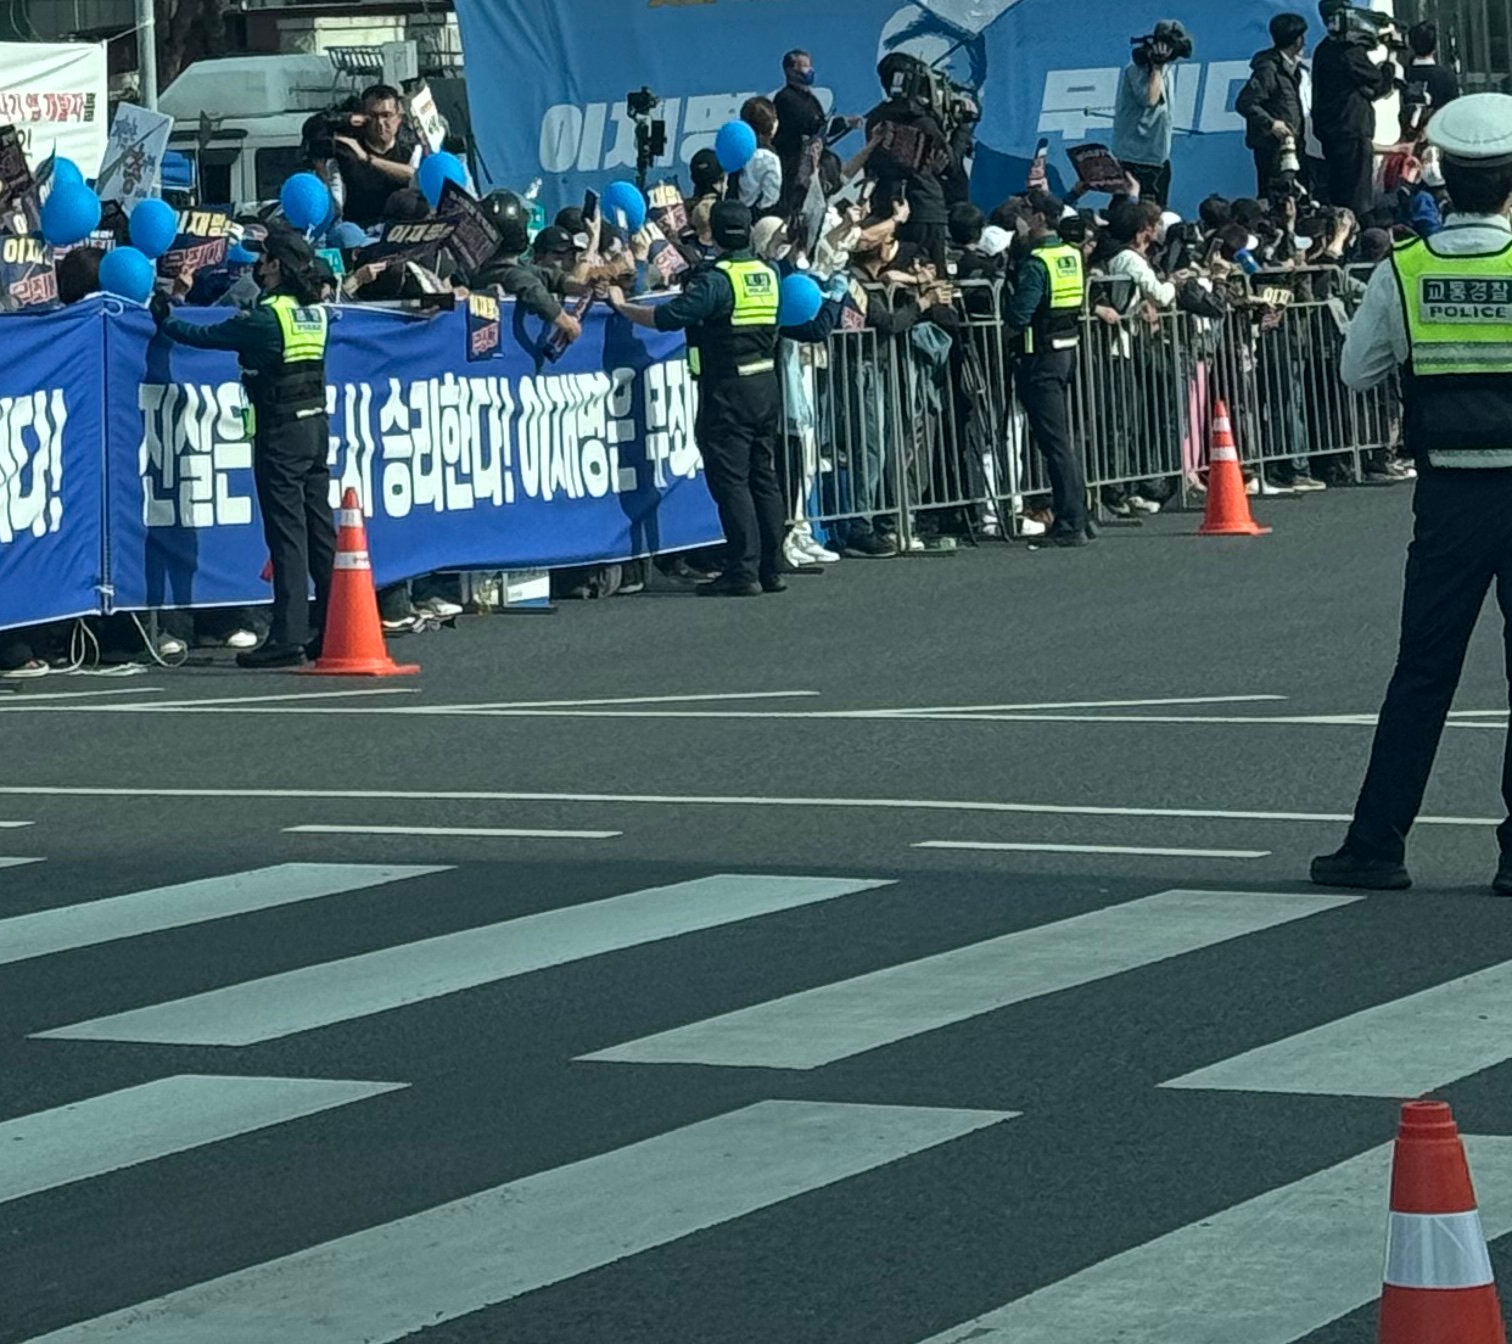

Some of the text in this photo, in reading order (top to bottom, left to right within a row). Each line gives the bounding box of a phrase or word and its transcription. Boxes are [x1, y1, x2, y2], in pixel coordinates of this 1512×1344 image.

[1427, 280, 1509, 302] 교통경찰
[1429, 305, 1508, 319] POLICE
[139, 381, 252, 527] 진실은
[380, 372, 515, 518] 승리한다!
[518, 367, 637, 501] 이재명은
[645, 358, 704, 489] 무죄
